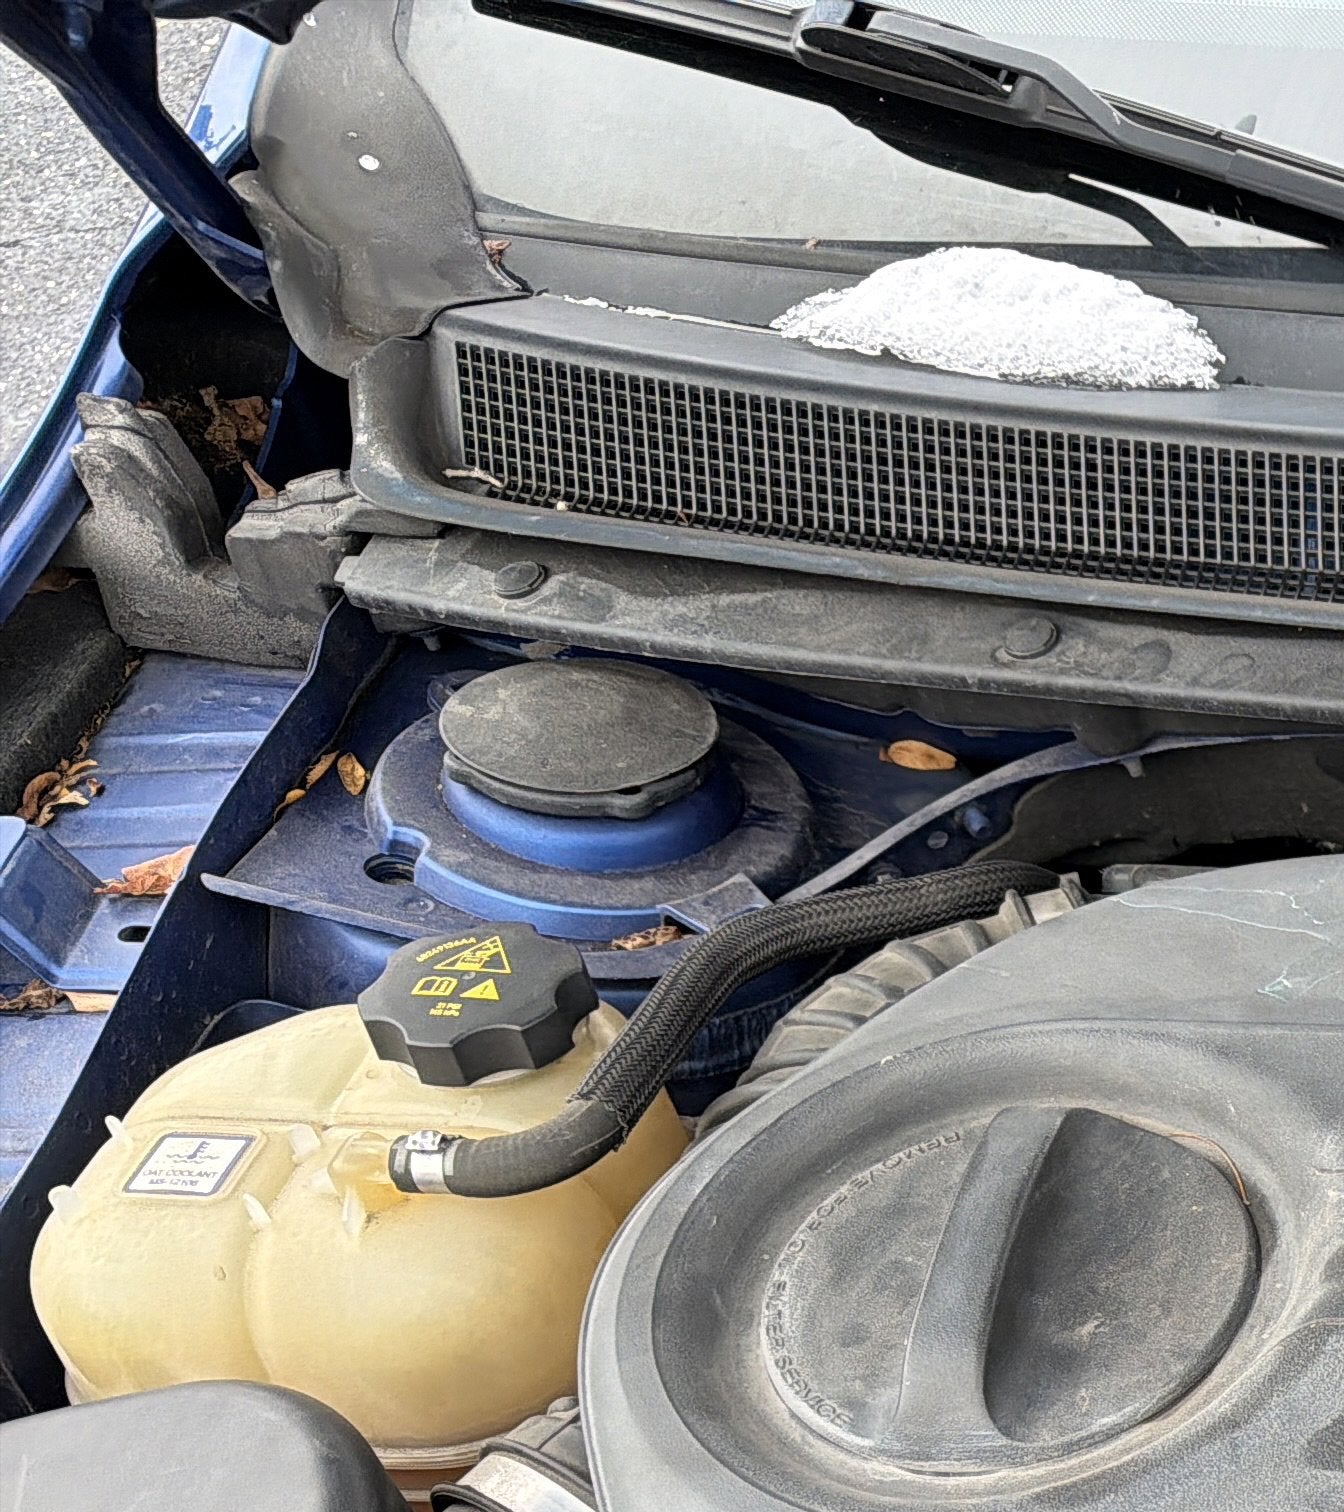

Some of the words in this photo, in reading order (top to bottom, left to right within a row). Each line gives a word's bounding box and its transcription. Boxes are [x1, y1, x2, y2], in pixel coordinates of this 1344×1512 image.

[166, 1169, 219, 1178] COOLANT
[850, 1130, 961, 1190] REMOVE
[807, 1195, 848, 1231] FOR
[764, 1280, 788, 1352] FILTER
[774, 1354, 855, 1430] SERVICE
